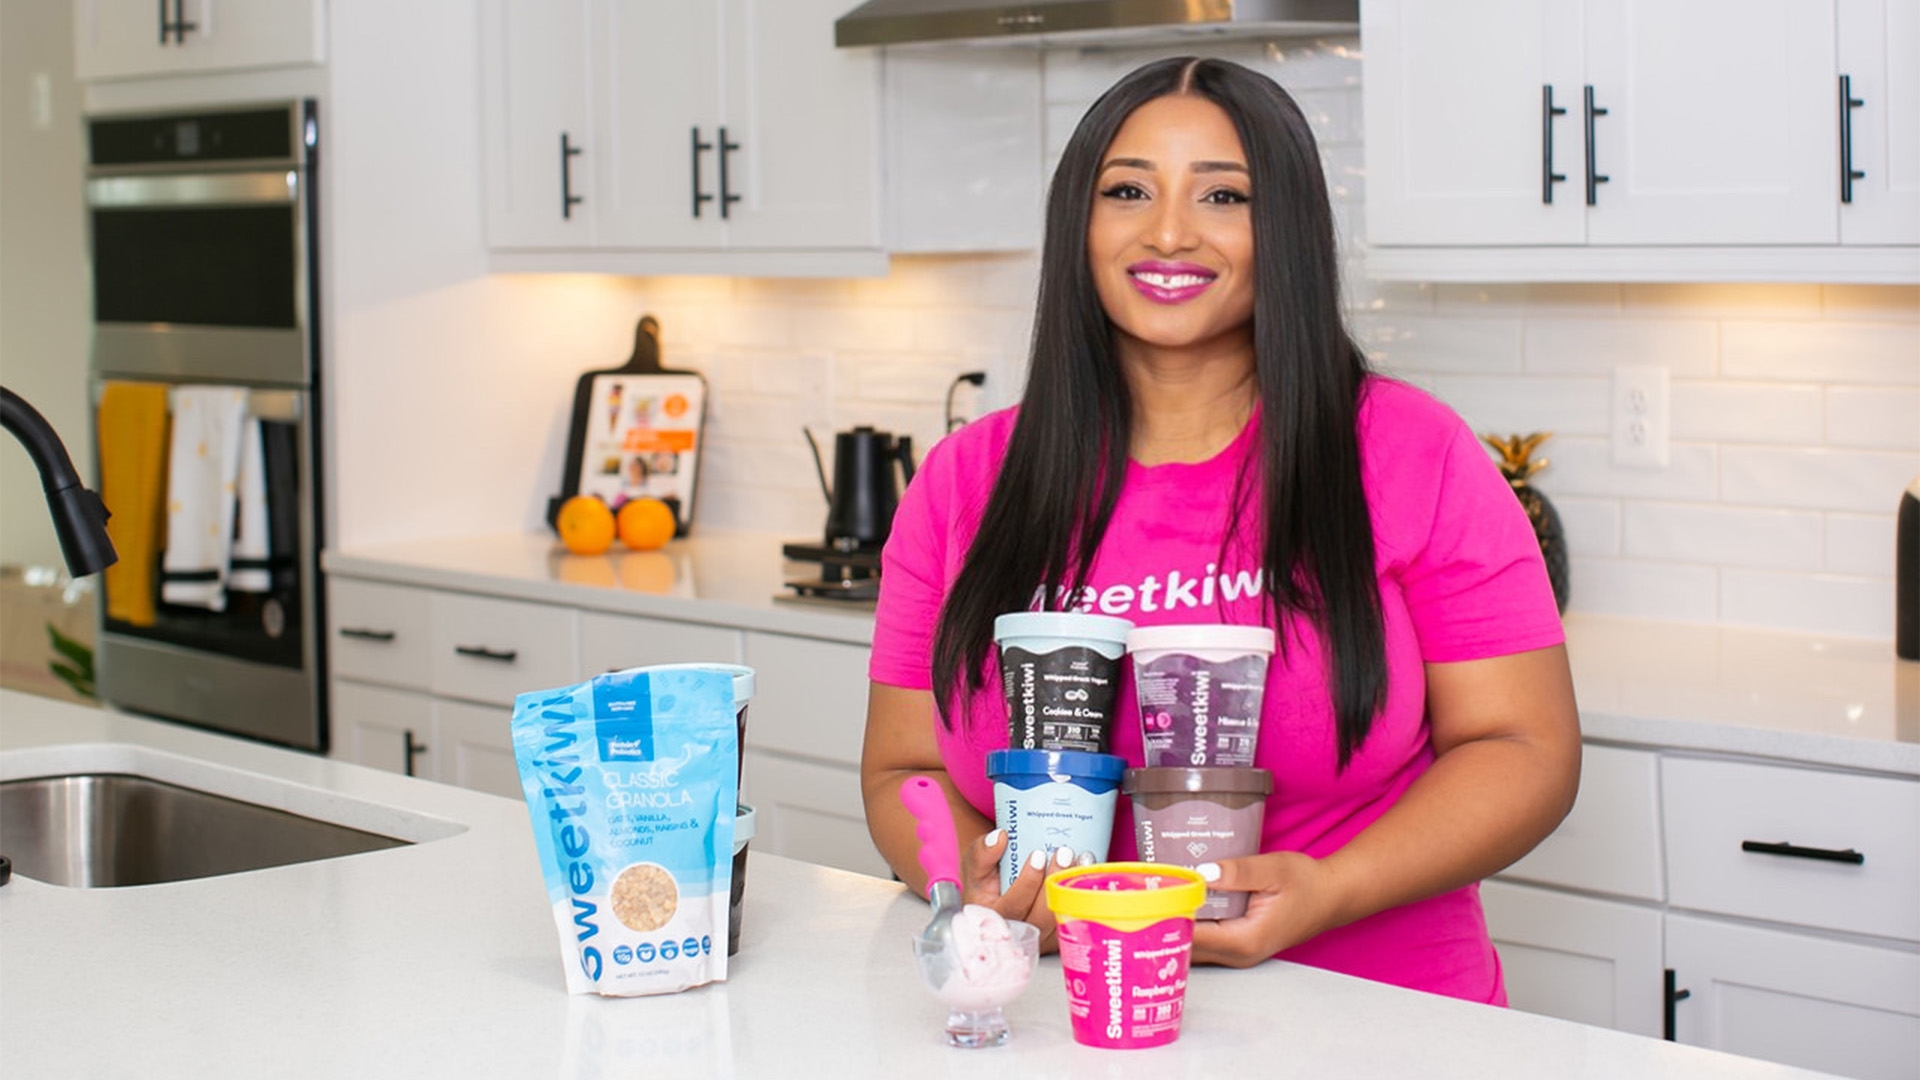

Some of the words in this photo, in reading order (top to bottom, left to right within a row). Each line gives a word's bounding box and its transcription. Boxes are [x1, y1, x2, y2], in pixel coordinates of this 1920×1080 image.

[1190, 671, 1210, 765] Sweetkiwi
[603, 771, 680, 789] CLASSIC
[605, 788, 694, 809] GRANOLA
[1027, 811, 1054, 820] Whipped
[1102, 939, 1122, 1039] Sweetkiwi
